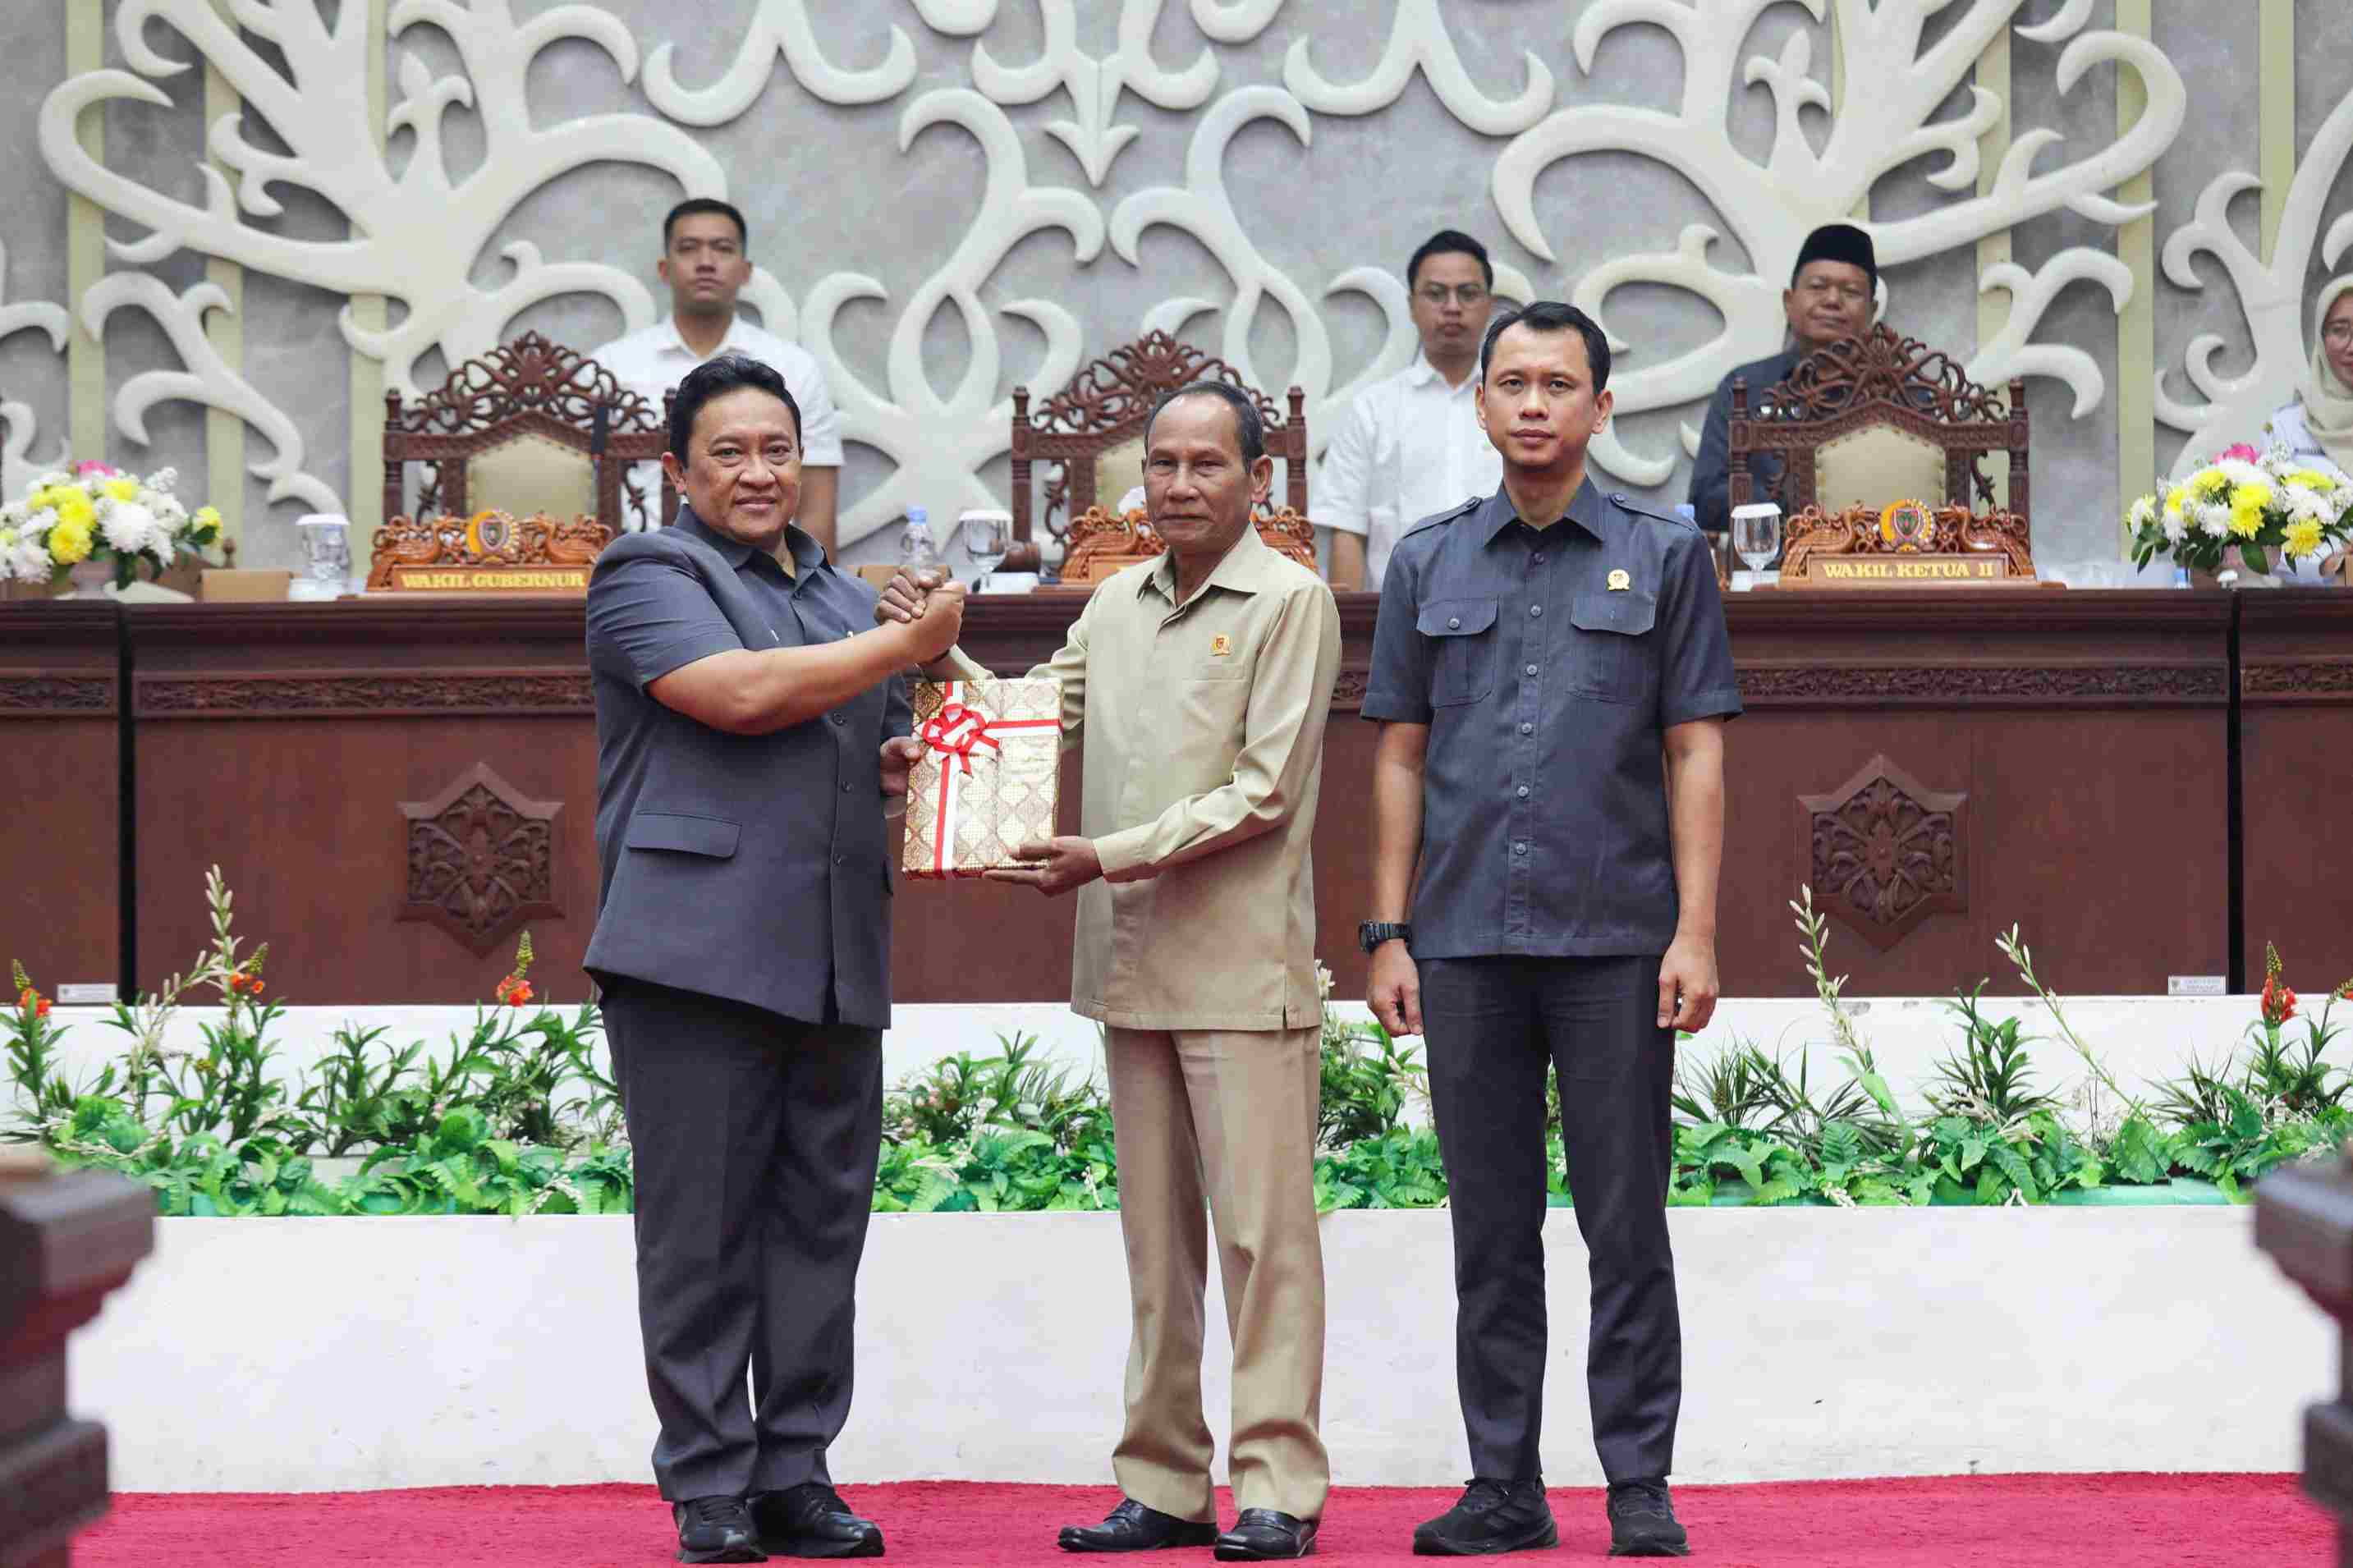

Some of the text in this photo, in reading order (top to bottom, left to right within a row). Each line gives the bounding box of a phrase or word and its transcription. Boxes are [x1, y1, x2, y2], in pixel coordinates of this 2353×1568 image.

[1823, 563, 1994, 578] WAKIL KETUA II
[401, 573, 585, 588] WAKIL GUBERNUR
